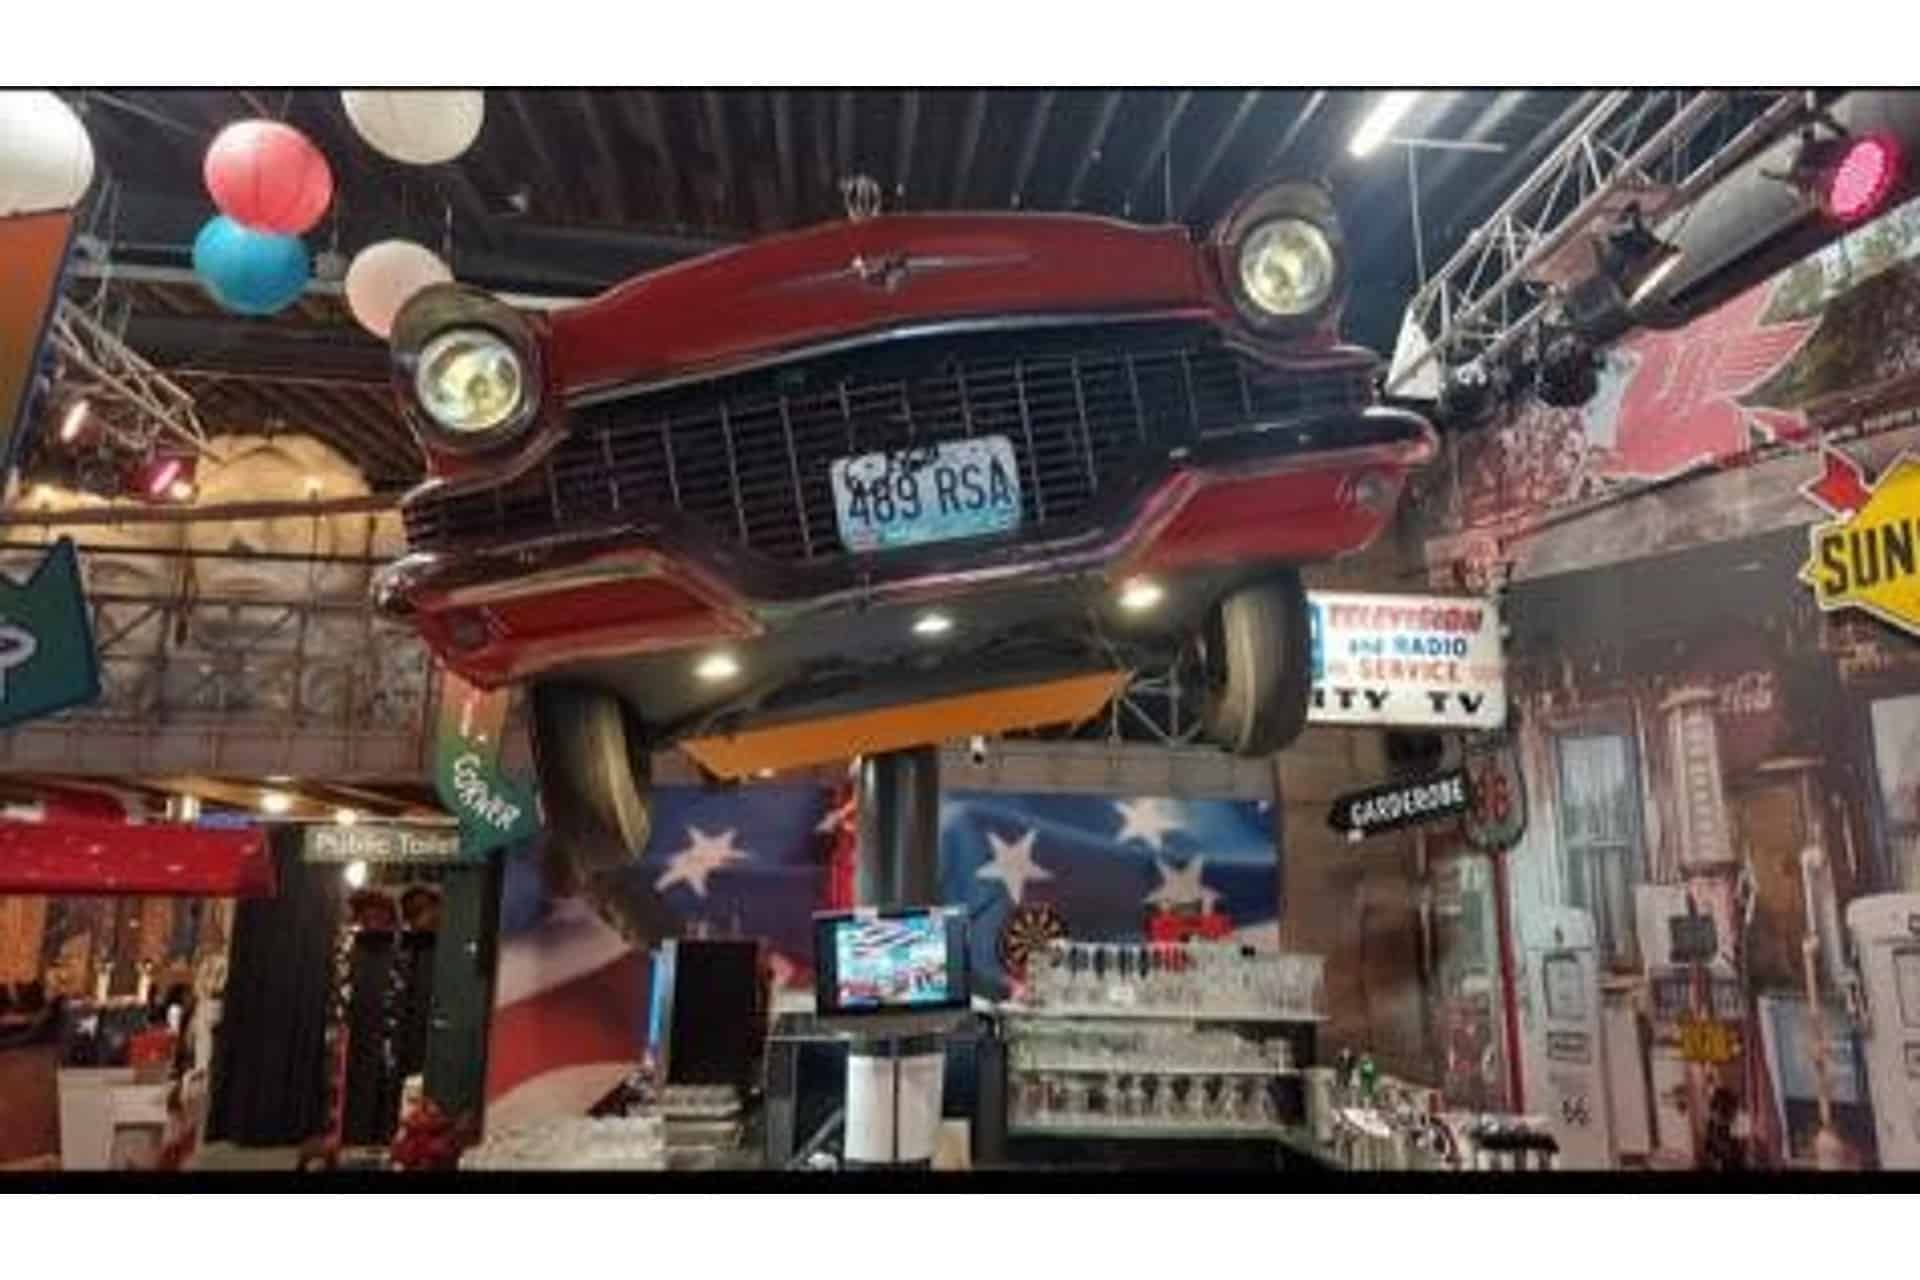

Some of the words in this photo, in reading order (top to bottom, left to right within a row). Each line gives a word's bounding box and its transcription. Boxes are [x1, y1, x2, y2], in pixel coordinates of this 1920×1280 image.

[934, 456, 1013, 516] RSA
[1820, 518, 1920, 597] SUN
[1327, 604, 1485, 634] TELEVISION
[1391, 636, 1468, 658] RADIO
[1359, 658, 1461, 682] SERVICE
[1426, 690, 1485, 714] TV
[1349, 775, 1466, 828] GARDEROBE
[315, 830, 391, 856] Public
